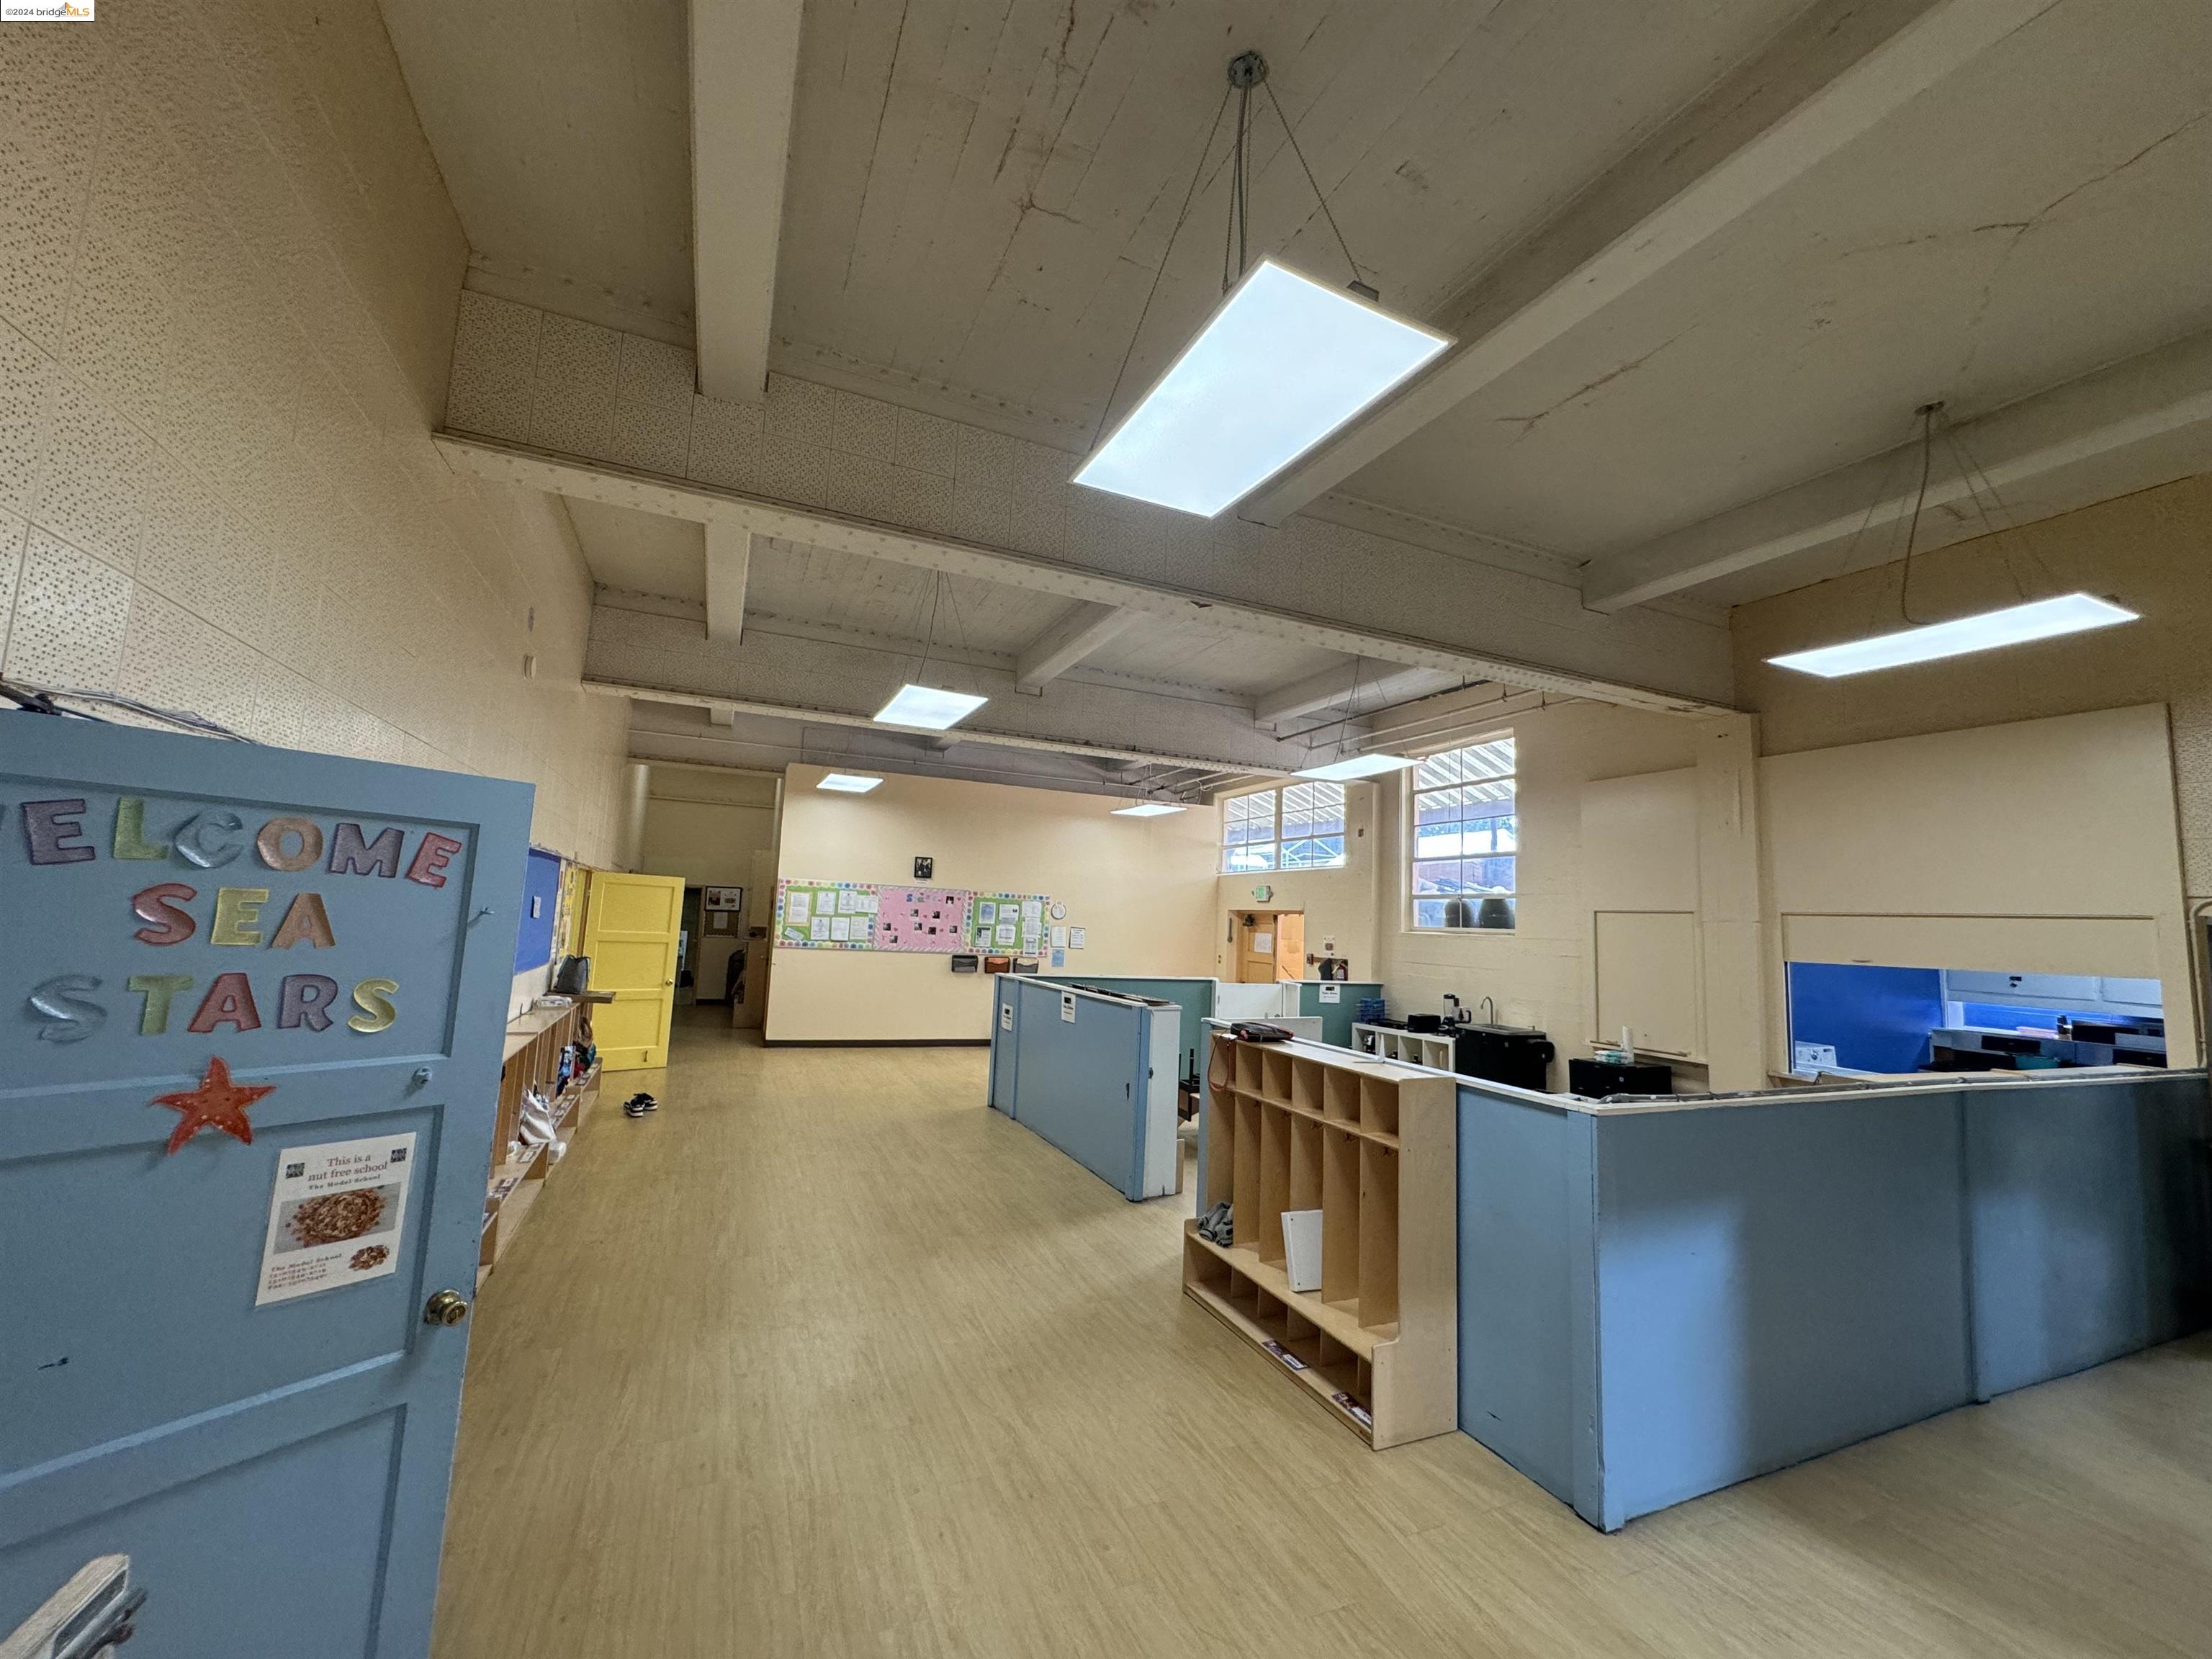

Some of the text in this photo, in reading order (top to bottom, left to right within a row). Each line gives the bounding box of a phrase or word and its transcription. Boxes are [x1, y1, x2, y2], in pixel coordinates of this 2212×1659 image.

[0, 797, 462, 888] ELCOME
[132, 883, 336, 949] SEA
[29, 972, 400, 1043] STARS
[308, 1161, 388, 1182] nut free school
[327, 1156, 351, 1167] This
[354, 1154, 363, 1164] is
